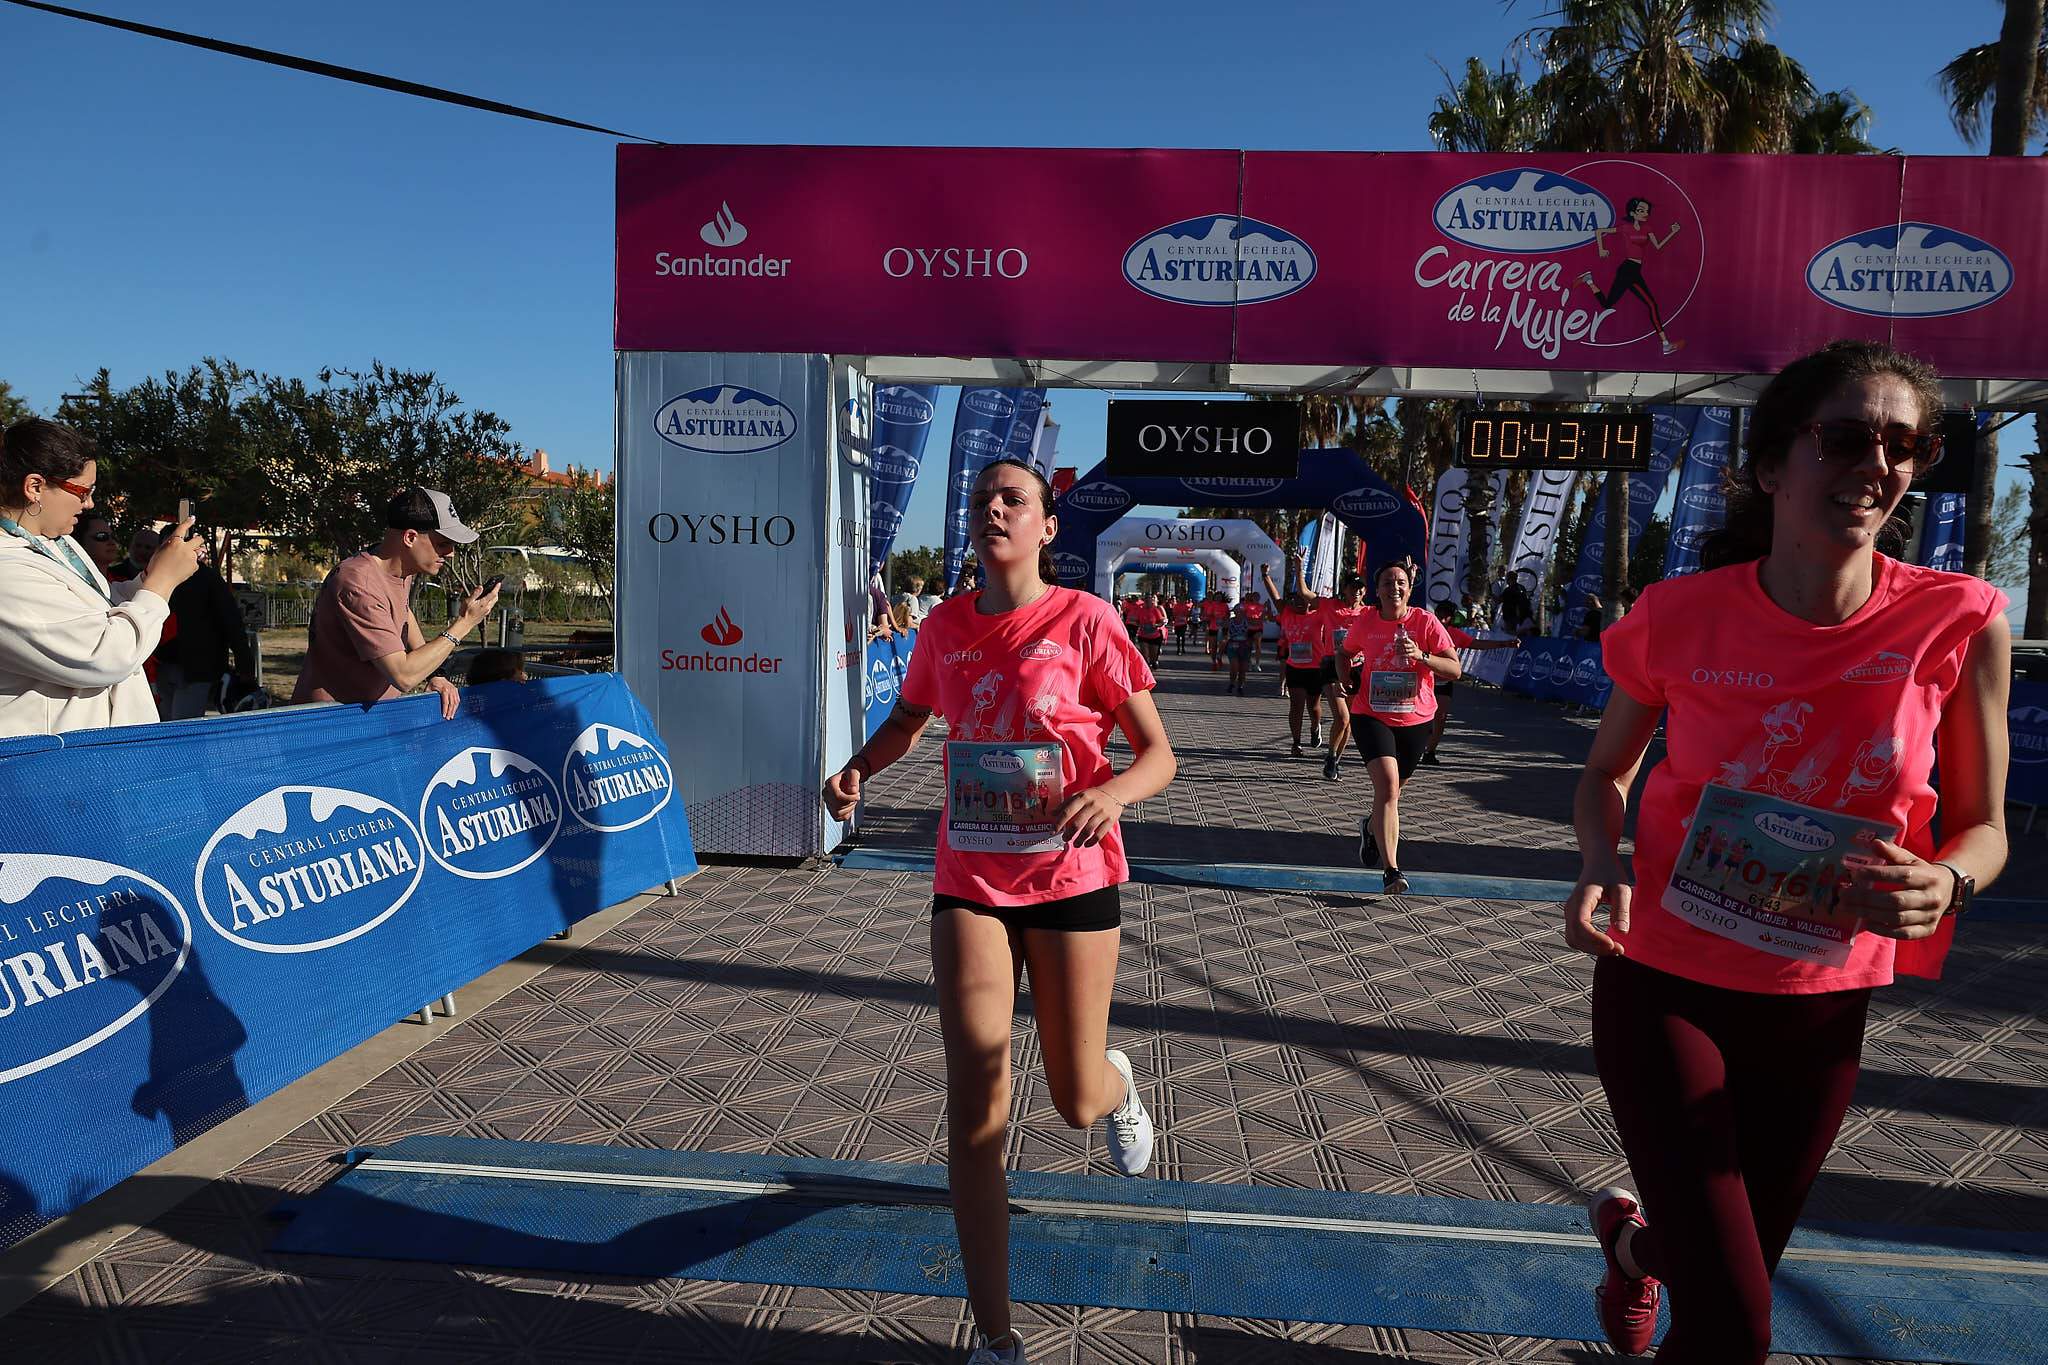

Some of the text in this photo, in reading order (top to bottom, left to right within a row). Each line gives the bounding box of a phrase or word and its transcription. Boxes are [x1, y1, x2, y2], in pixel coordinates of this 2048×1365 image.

[1446, 198, 1599, 232] ASTURIANA
[1475, 197, 1596, 206] CENTRAL LECHERA
[656, 252, 791, 277] Santander
[883, 247, 1028, 278] OYSHO
[1137, 248, 1301, 282] ASTURIANA
[1167, 246, 1228, 255] CENTRAL
[1854, 255, 1991, 265] CENTRAL LECHERA
[1414, 245, 1562, 291] Carrera
[1821, 256, 1996, 293] ASTURIANA
[1447, 288, 1616, 360] de la Mujer
[665, 409, 786, 437] ASTURIANA
[687, 408, 782, 417] CENTRAL LECHERA
[1138, 424, 1273, 455] OYSHO
[1471, 420, 1639, 460] 00:43:14
[1070, 489, 1126, 506] ASTURIANA
[1337, 497, 1398, 511] ASTURIANA
[648, 513, 795, 546] OYSHO
[837, 517, 866, 550] OYSHO
[1145, 524, 1225, 542] OYSHO
[1428, 490, 1465, 604] OYSHO
[661, 649, 783, 673] Santander
[1692, 668, 1774, 689] OYSHO
[583, 751, 654, 775] CENTRAL LECHERA
[452, 776, 543, 811] CENTRAL LECHERA
[573, 764, 669, 813] ASTURIANA
[249, 816, 395, 868] CENTRAL LECHERA
[437, 793, 557, 859] ASTURIANA
[953, 822, 980, 830] CARRERA
[958, 835, 993, 845] OYSHO
[1759, 816, 1829, 848] ASTURIANA
[223, 836, 417, 931] ASTURIANA
[25, 888, 142, 934] LECHERA
[1679, 878, 1842, 939] CARRERA DE LA MUJER VALENCIA
[1680, 899, 1829, 956] OYSHO Santander
[0, 912, 177, 1018] RIANA
